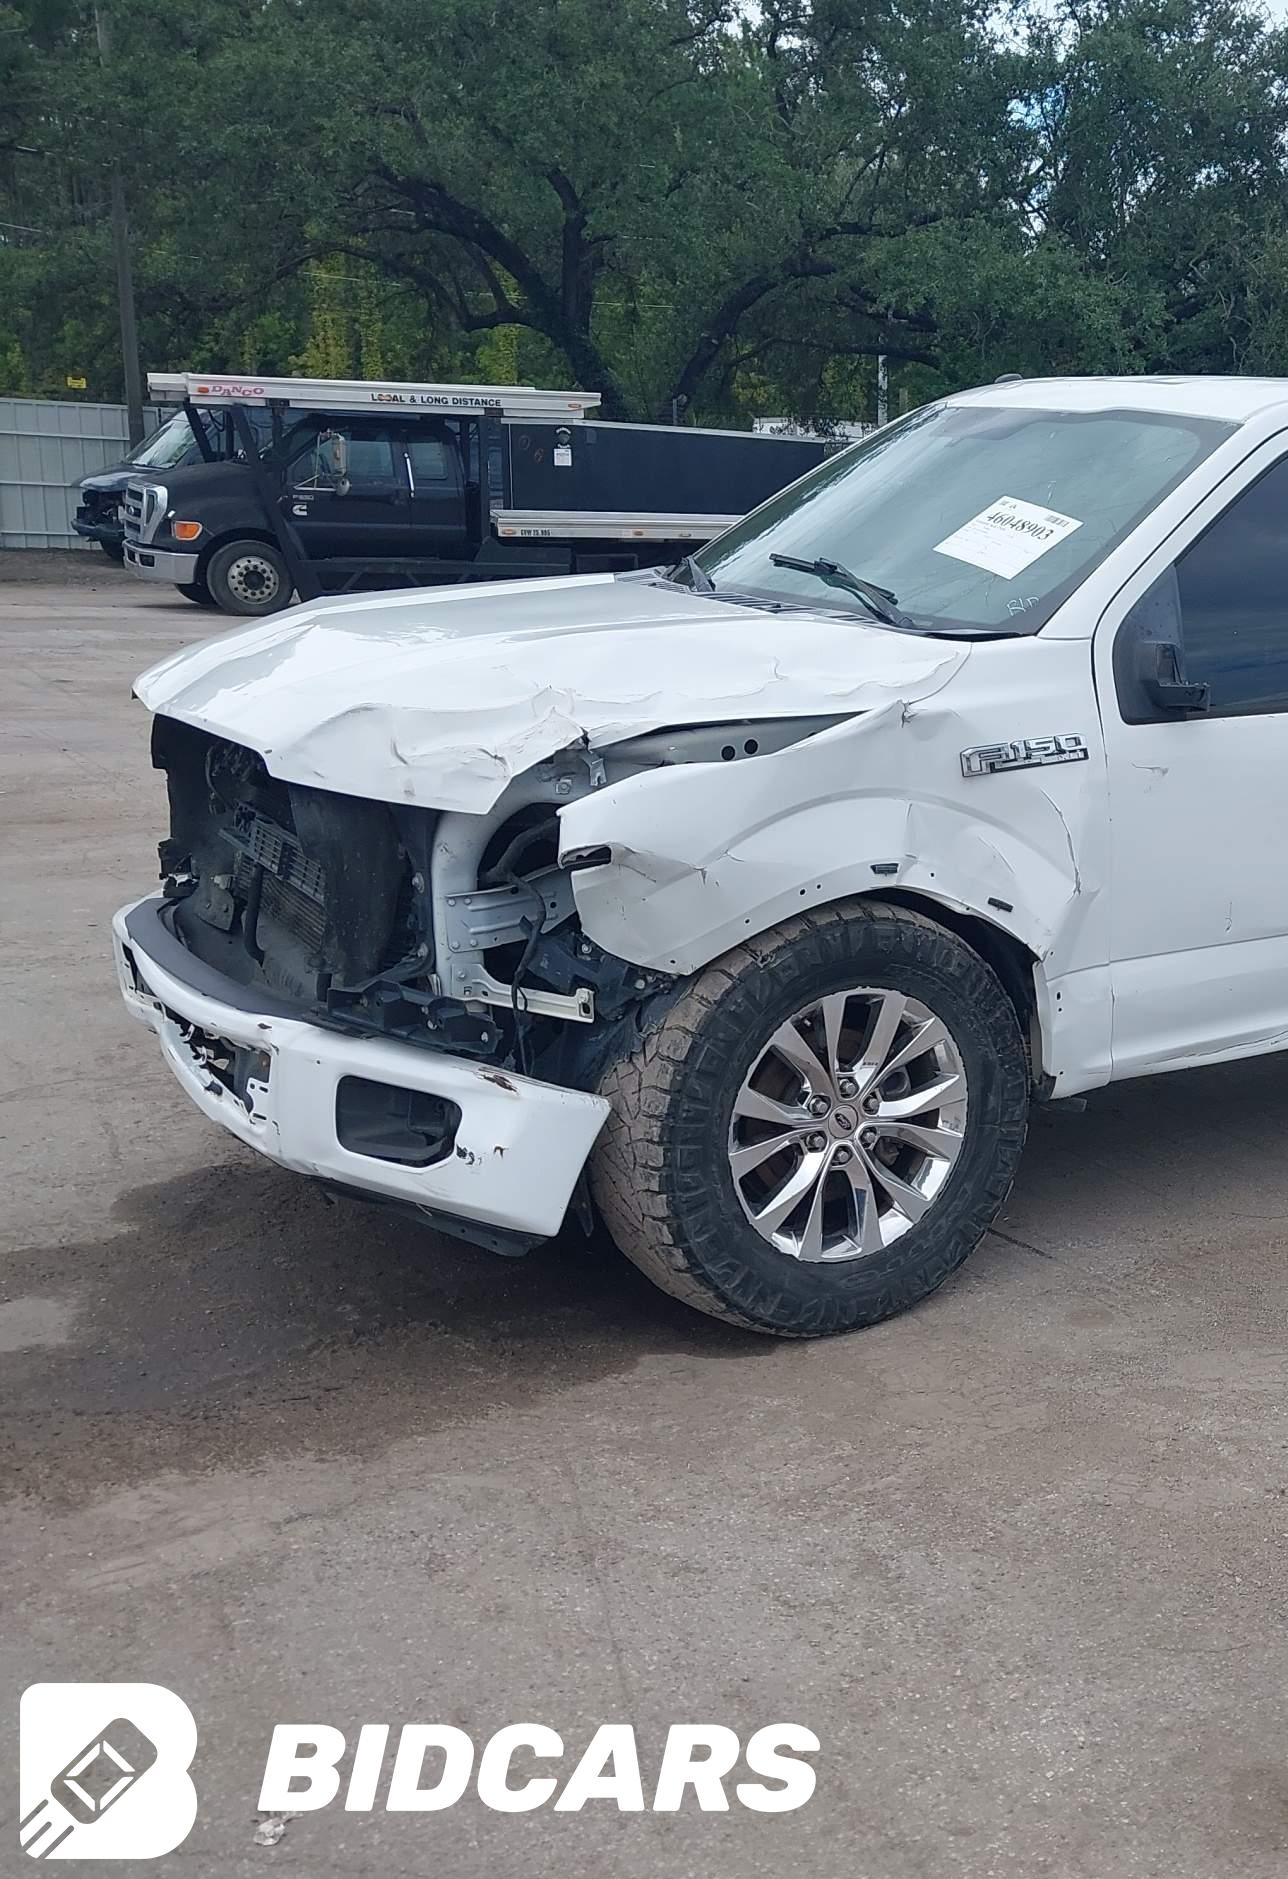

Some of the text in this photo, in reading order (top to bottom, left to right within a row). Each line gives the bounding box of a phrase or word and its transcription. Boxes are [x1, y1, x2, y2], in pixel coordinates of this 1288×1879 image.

[211, 385, 265, 396] DANCO
[370, 393, 501, 407] LOCAL & LONG DISTANCE
[987, 512, 1054, 540] 46048903
